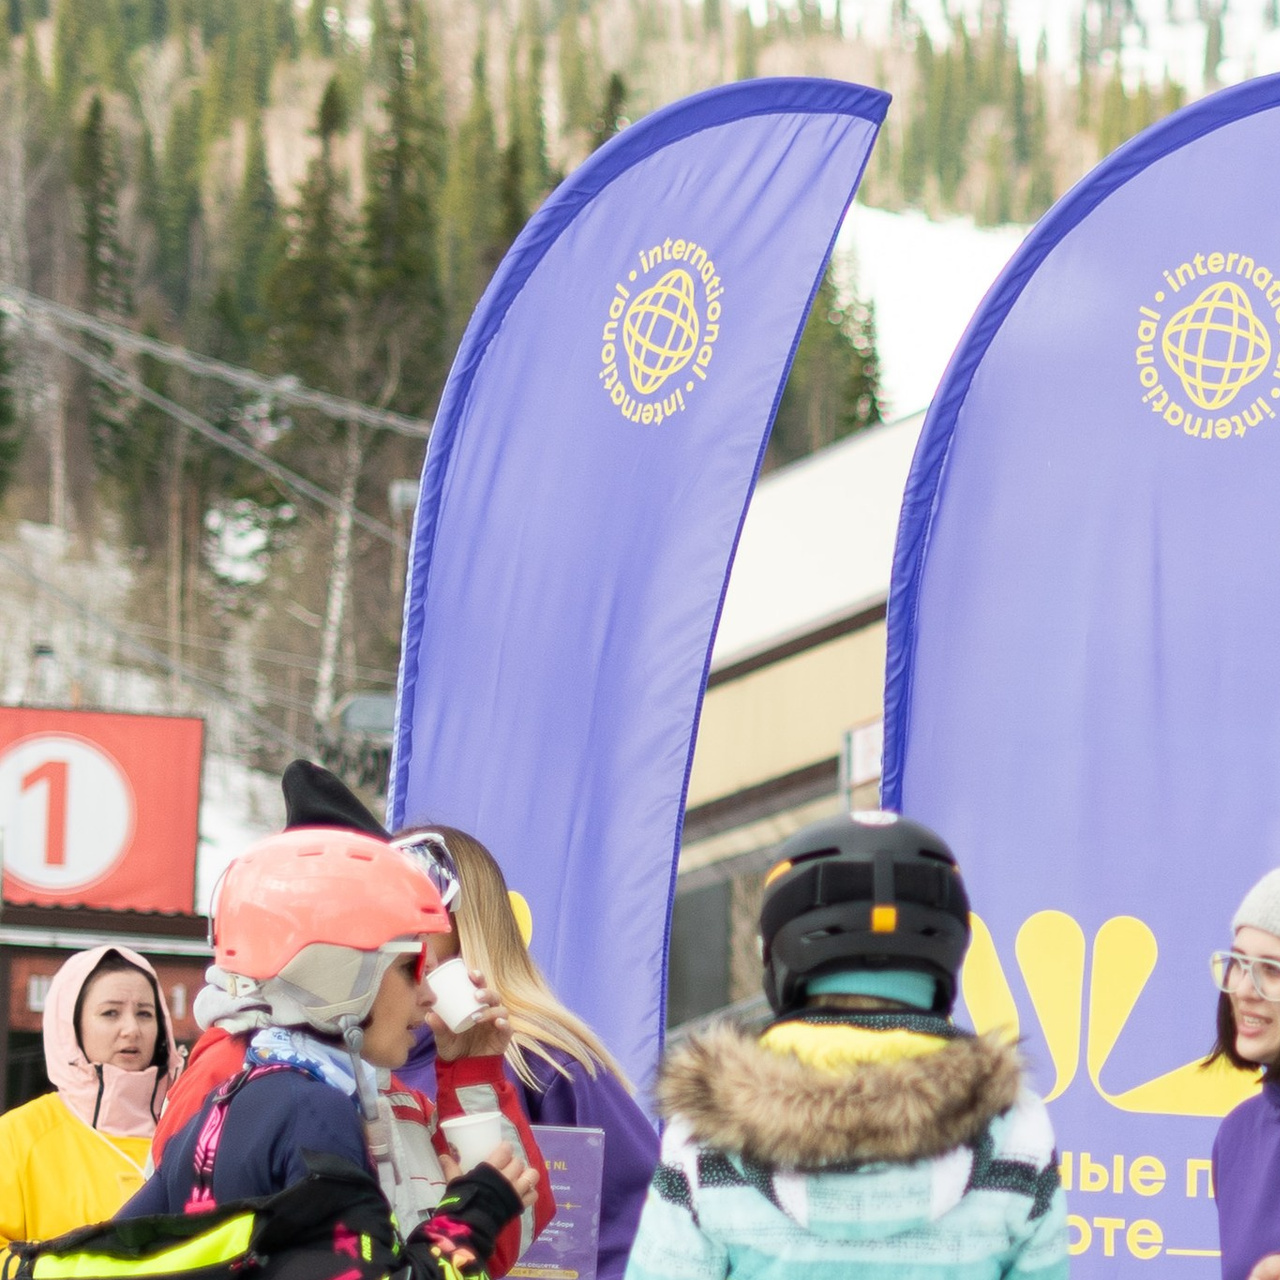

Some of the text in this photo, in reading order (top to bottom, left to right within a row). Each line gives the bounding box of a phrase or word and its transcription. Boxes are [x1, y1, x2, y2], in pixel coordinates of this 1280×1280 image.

[639, 237, 724, 381] international
[20, 761, 70, 865] 1
[1185, 1158, 1215, 1198] п
